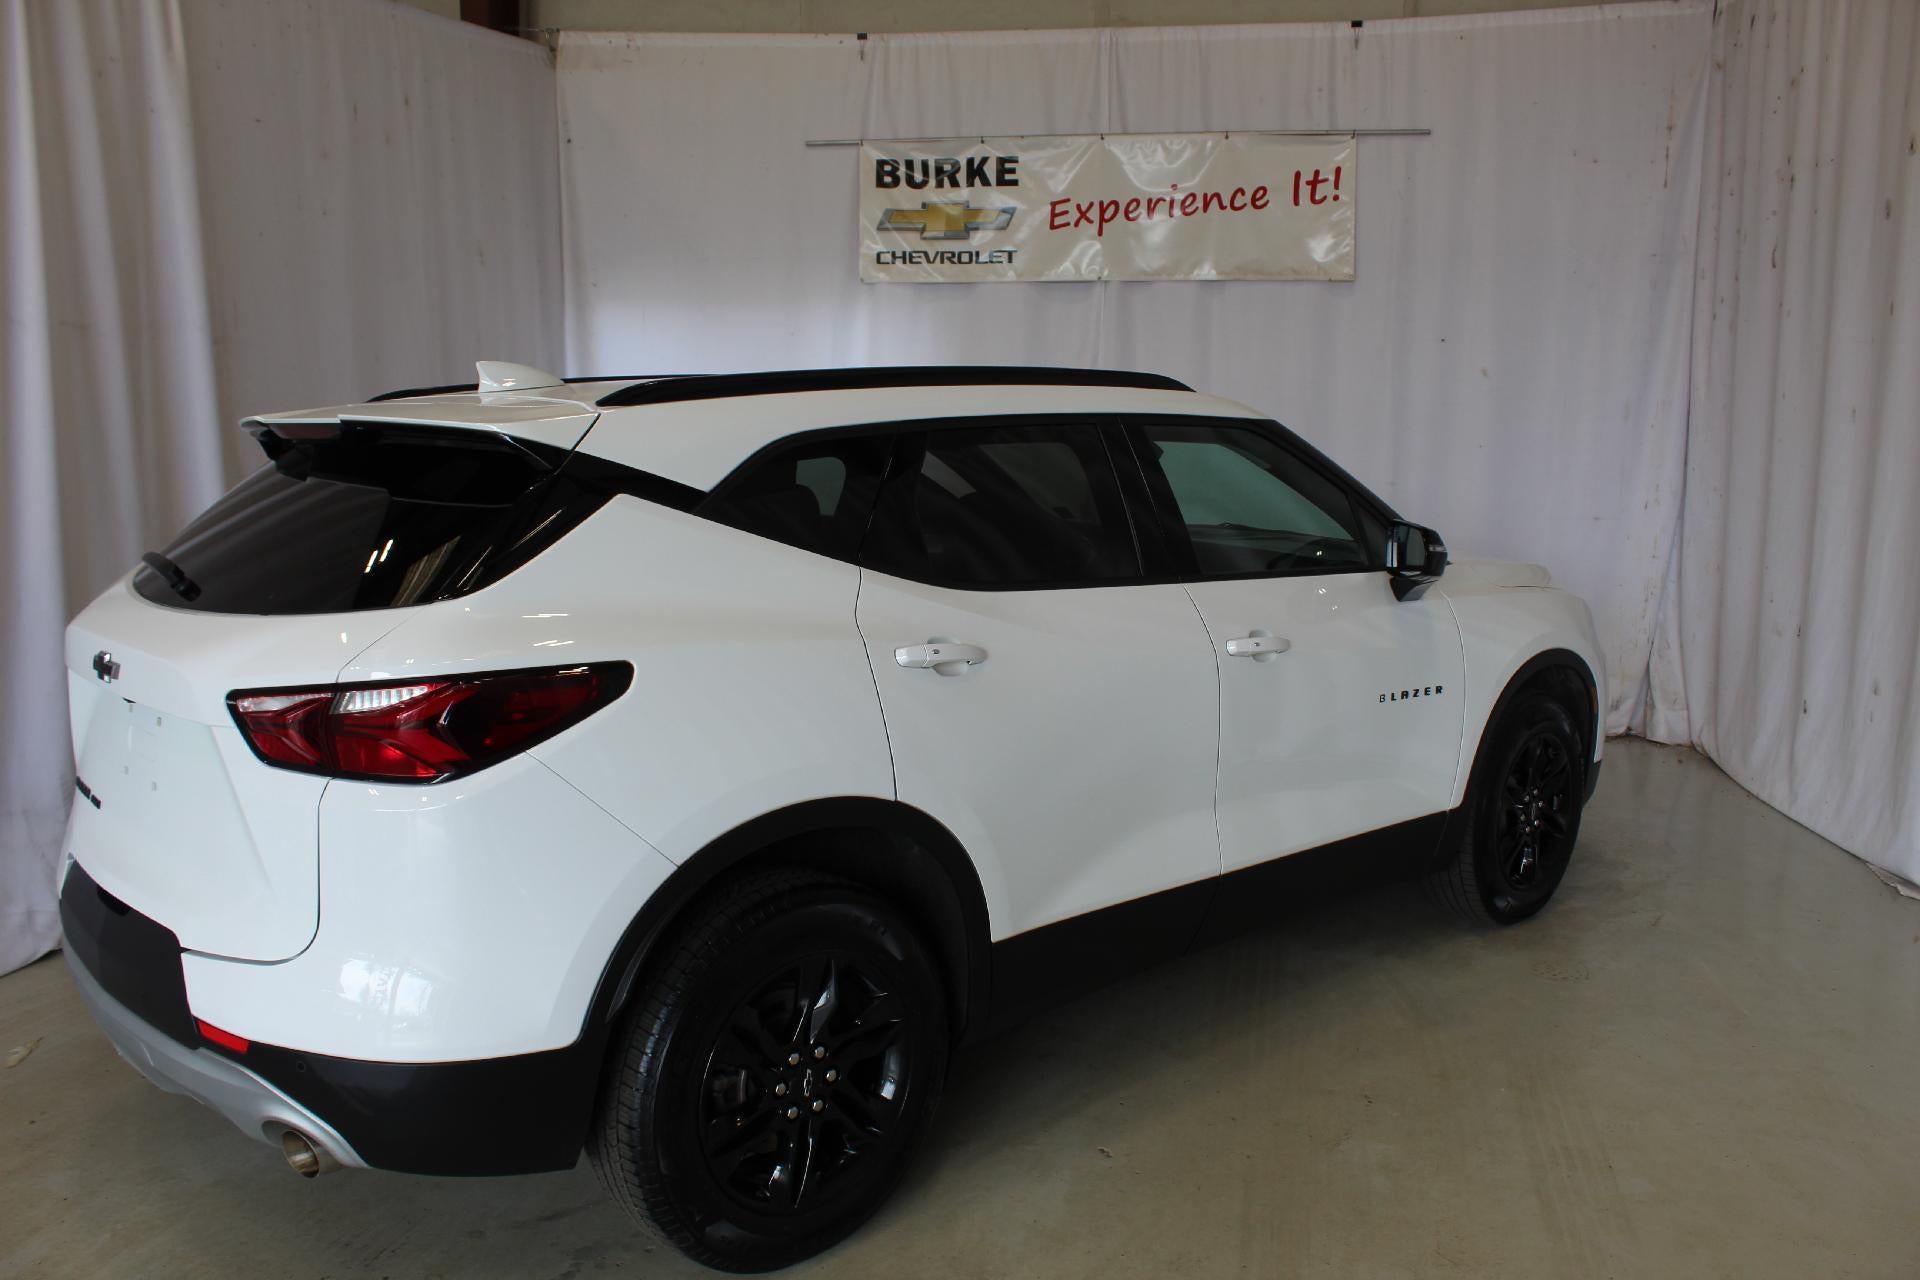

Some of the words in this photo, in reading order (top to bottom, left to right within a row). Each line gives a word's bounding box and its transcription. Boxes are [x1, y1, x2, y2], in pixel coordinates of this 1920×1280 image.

[875, 156, 1019, 189] BURKE
[1049, 184, 1270, 237] Experience
[1292, 166, 1343, 207] It!
[876, 250, 1018, 265] CHEVROLET
[1378, 684, 1444, 703] BLAZER
